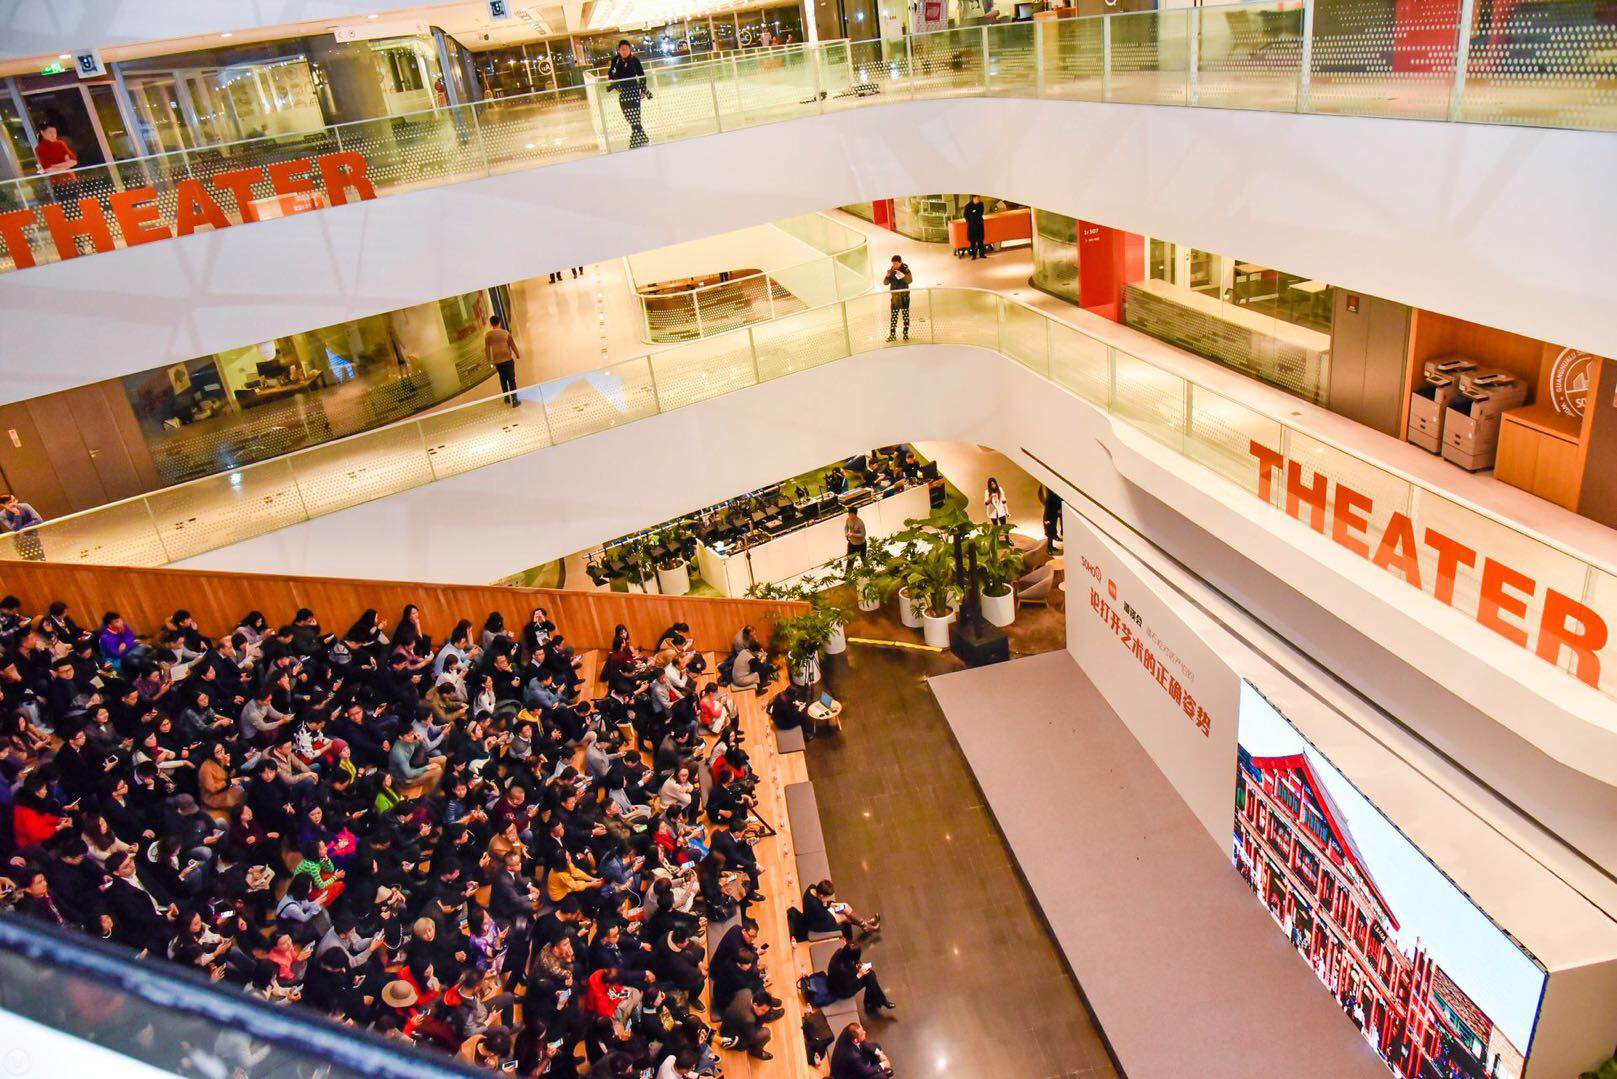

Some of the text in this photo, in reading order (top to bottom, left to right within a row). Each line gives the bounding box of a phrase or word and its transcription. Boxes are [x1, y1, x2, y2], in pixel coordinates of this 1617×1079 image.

[0, 151, 376, 270] THEATER
[1250, 439, 1608, 691] THEATER
[1090, 587, 1212, 738] 论打开艺术的正确姿势
